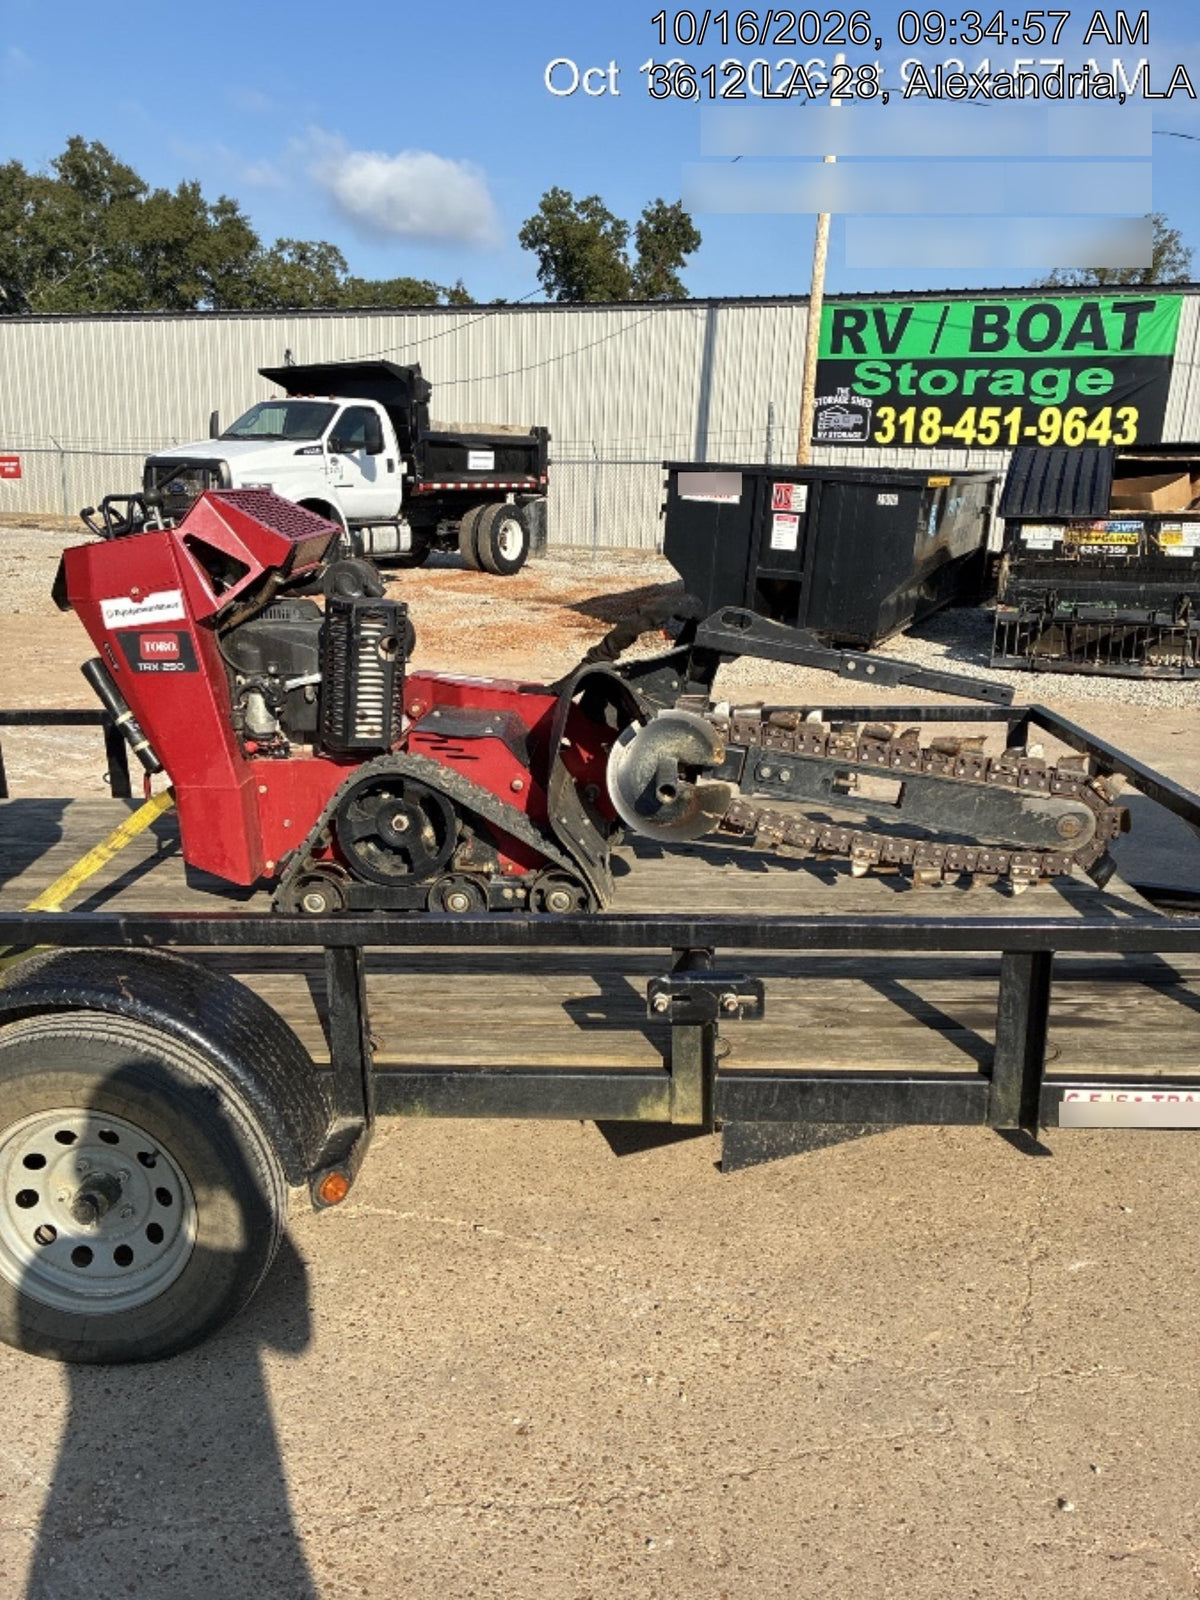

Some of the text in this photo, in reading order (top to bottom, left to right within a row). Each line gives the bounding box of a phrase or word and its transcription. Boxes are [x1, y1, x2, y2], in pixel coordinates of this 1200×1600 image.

[830, 301, 1157, 354] RV / BOAT
[851, 360, 1115, 405] Storage
[874, 405, 1139, 447] 318-451-9643
[143, 641, 176, 653] TORO
